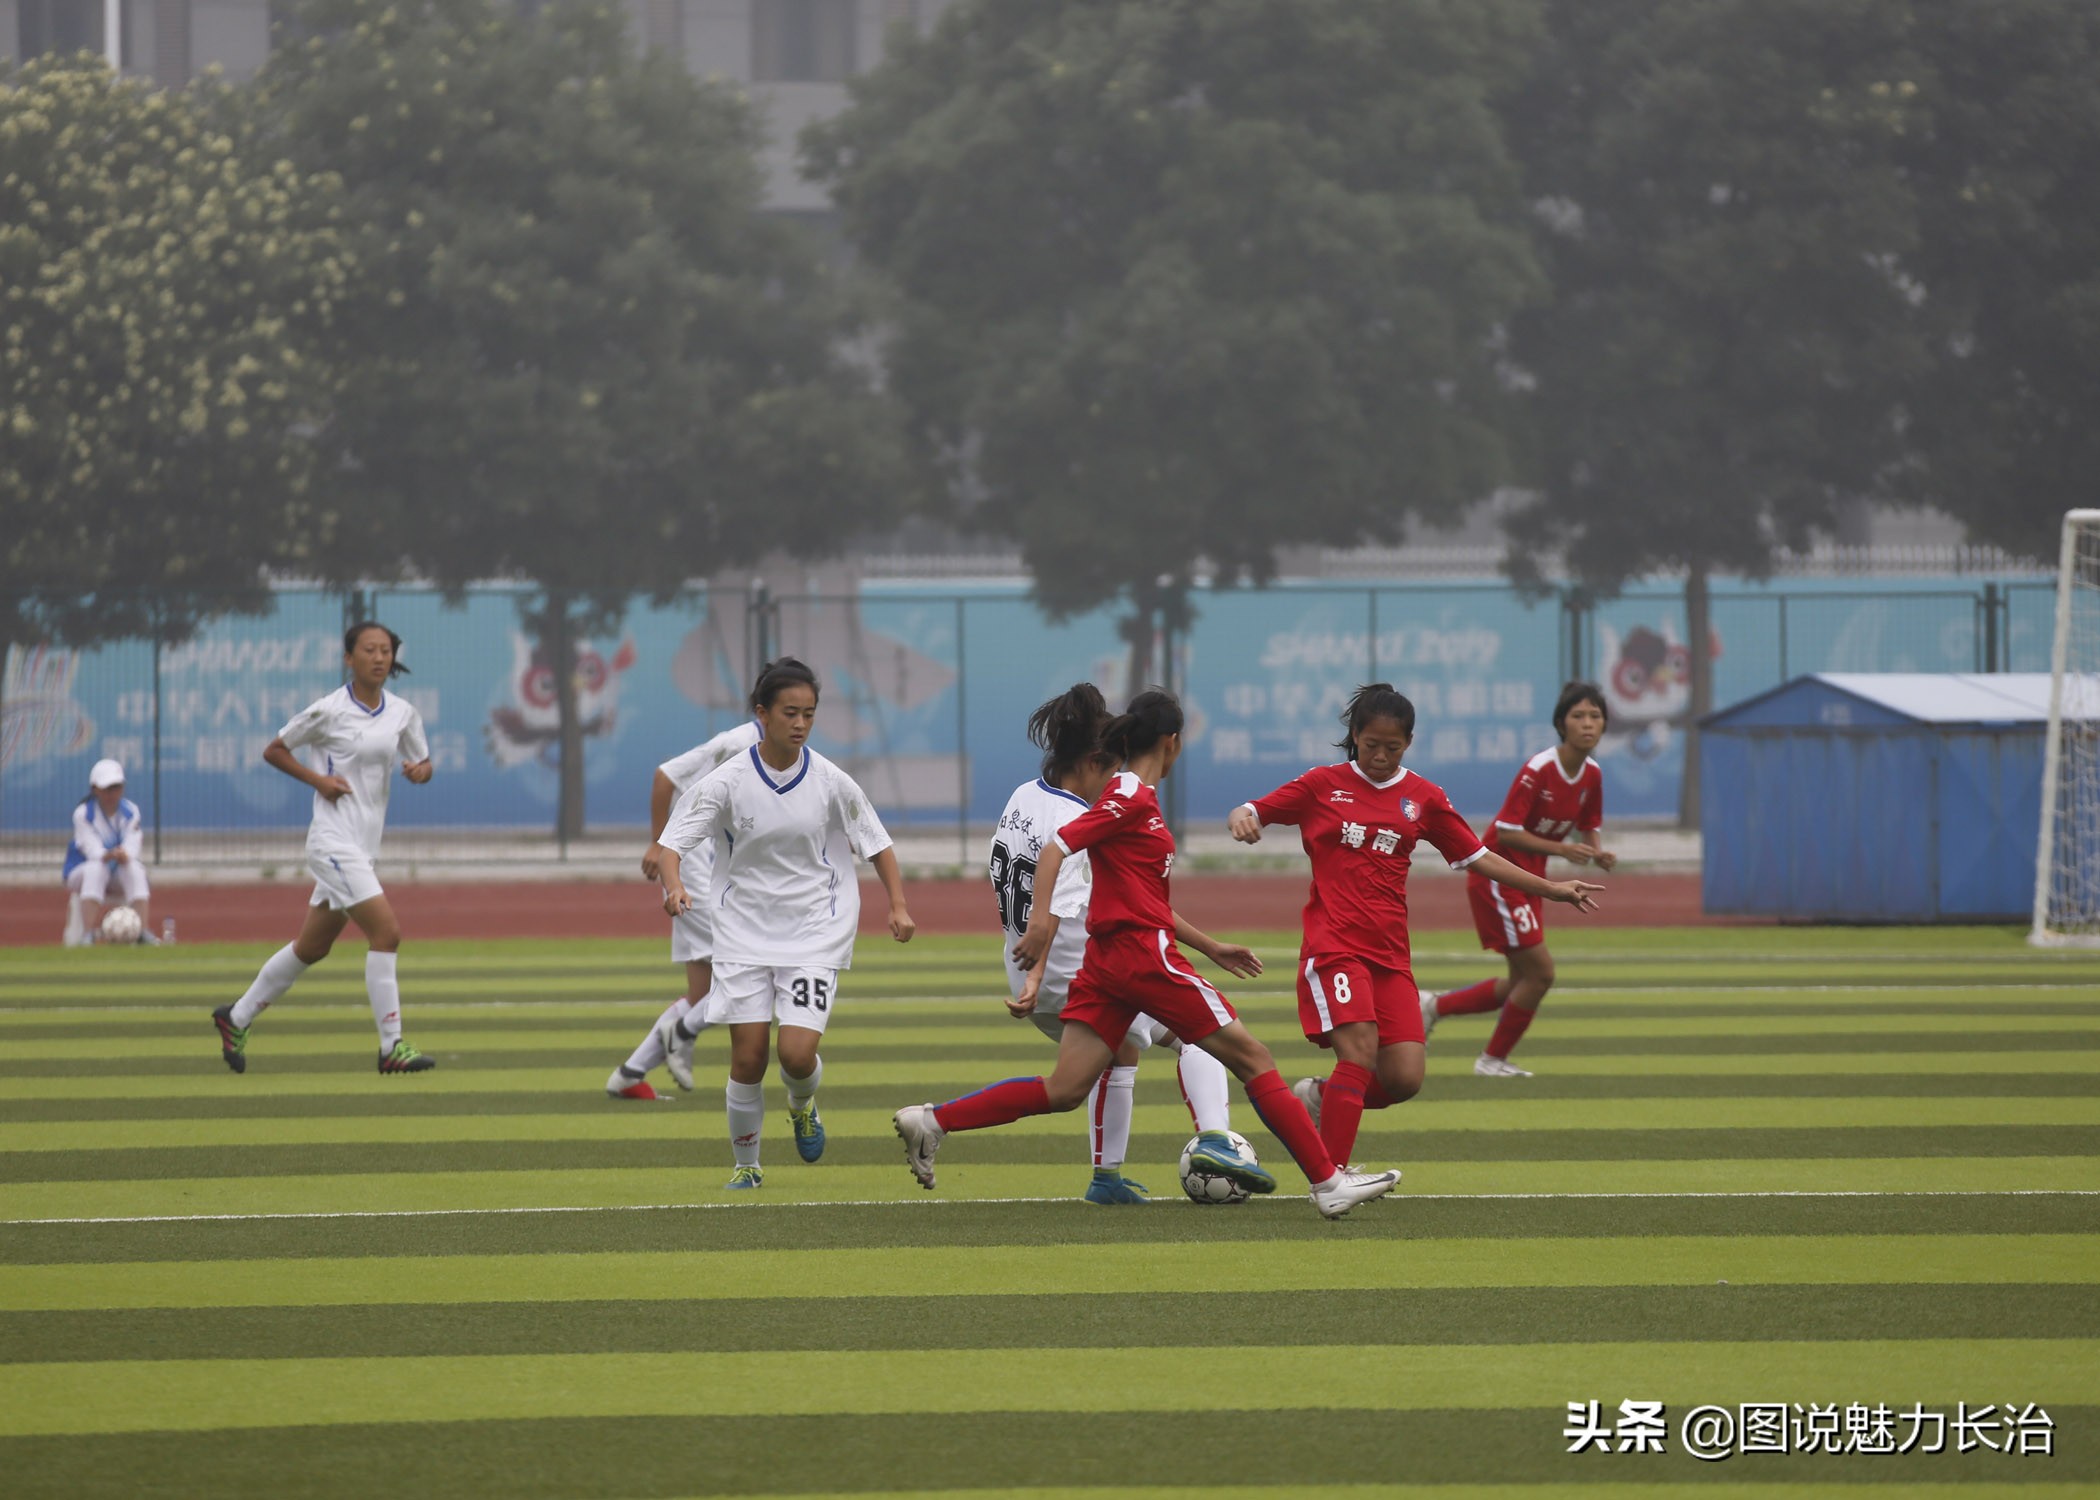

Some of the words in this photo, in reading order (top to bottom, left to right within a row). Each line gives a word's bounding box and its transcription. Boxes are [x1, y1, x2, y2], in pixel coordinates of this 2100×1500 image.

[1223, 681, 1534, 717] 中华人共和国
[1340, 821, 1402, 855] 海南
[791, 977, 827, 1012] 35
[1333, 972, 1352, 1004] 8
